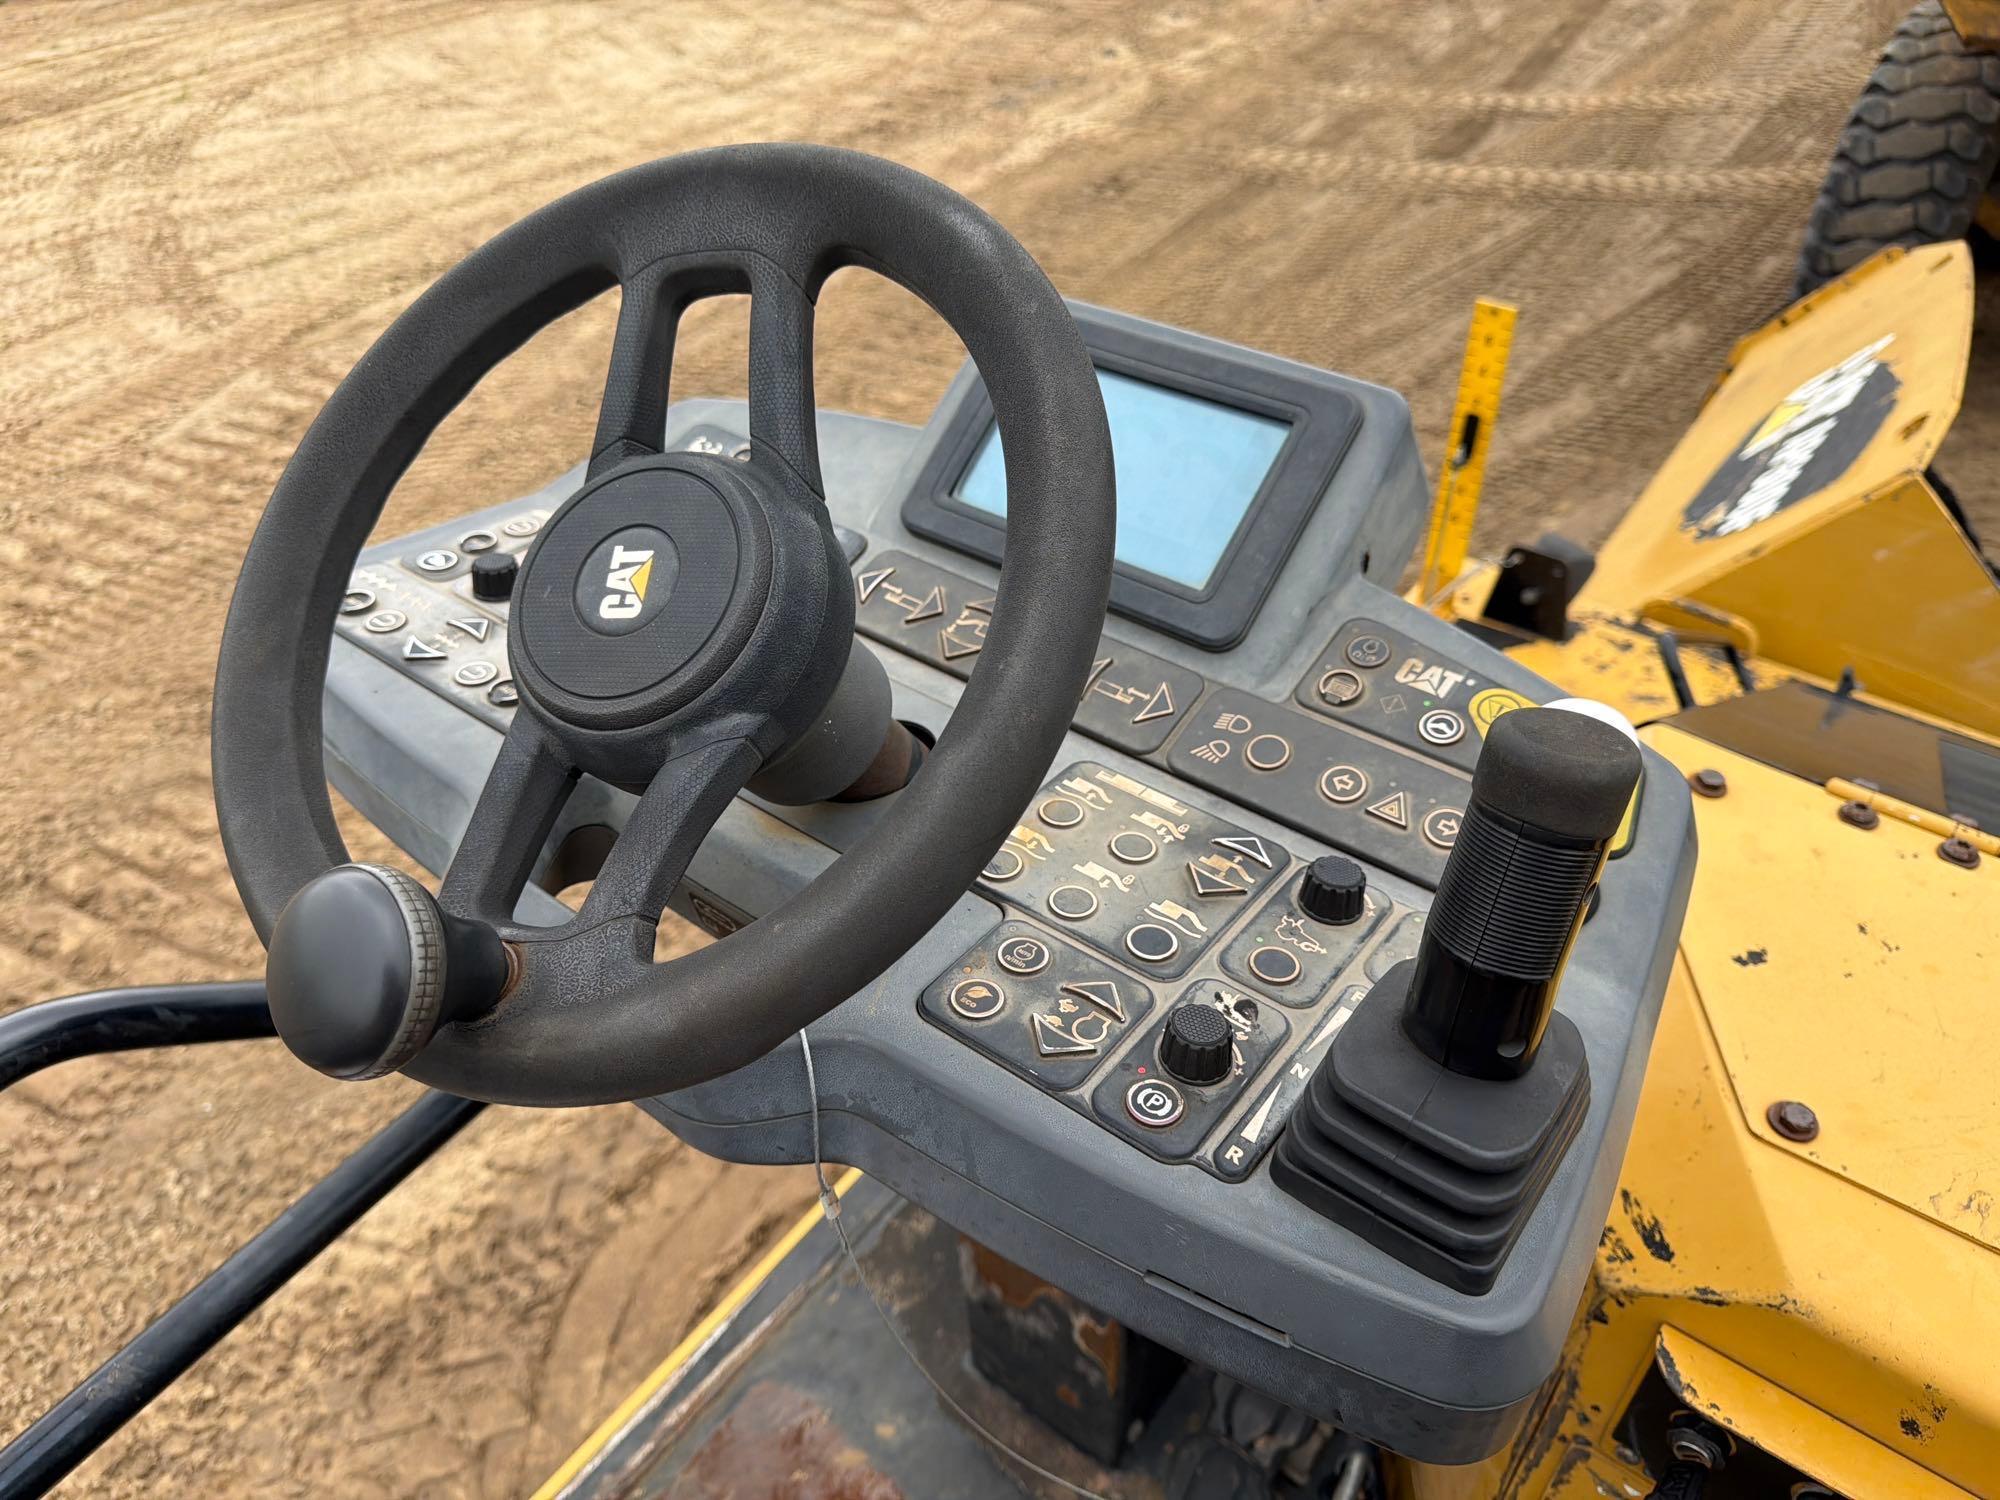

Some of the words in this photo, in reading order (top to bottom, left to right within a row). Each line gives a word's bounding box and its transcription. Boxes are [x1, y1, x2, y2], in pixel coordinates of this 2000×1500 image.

[599, 546, 655, 618] CAT
[1394, 658, 1464, 699] CAT
[960, 997, 976, 1008] ECO
[1290, 1062, 1310, 1079] N
[1146, 1094, 1164, 1107] P
[1224, 1144, 1244, 1166] R
